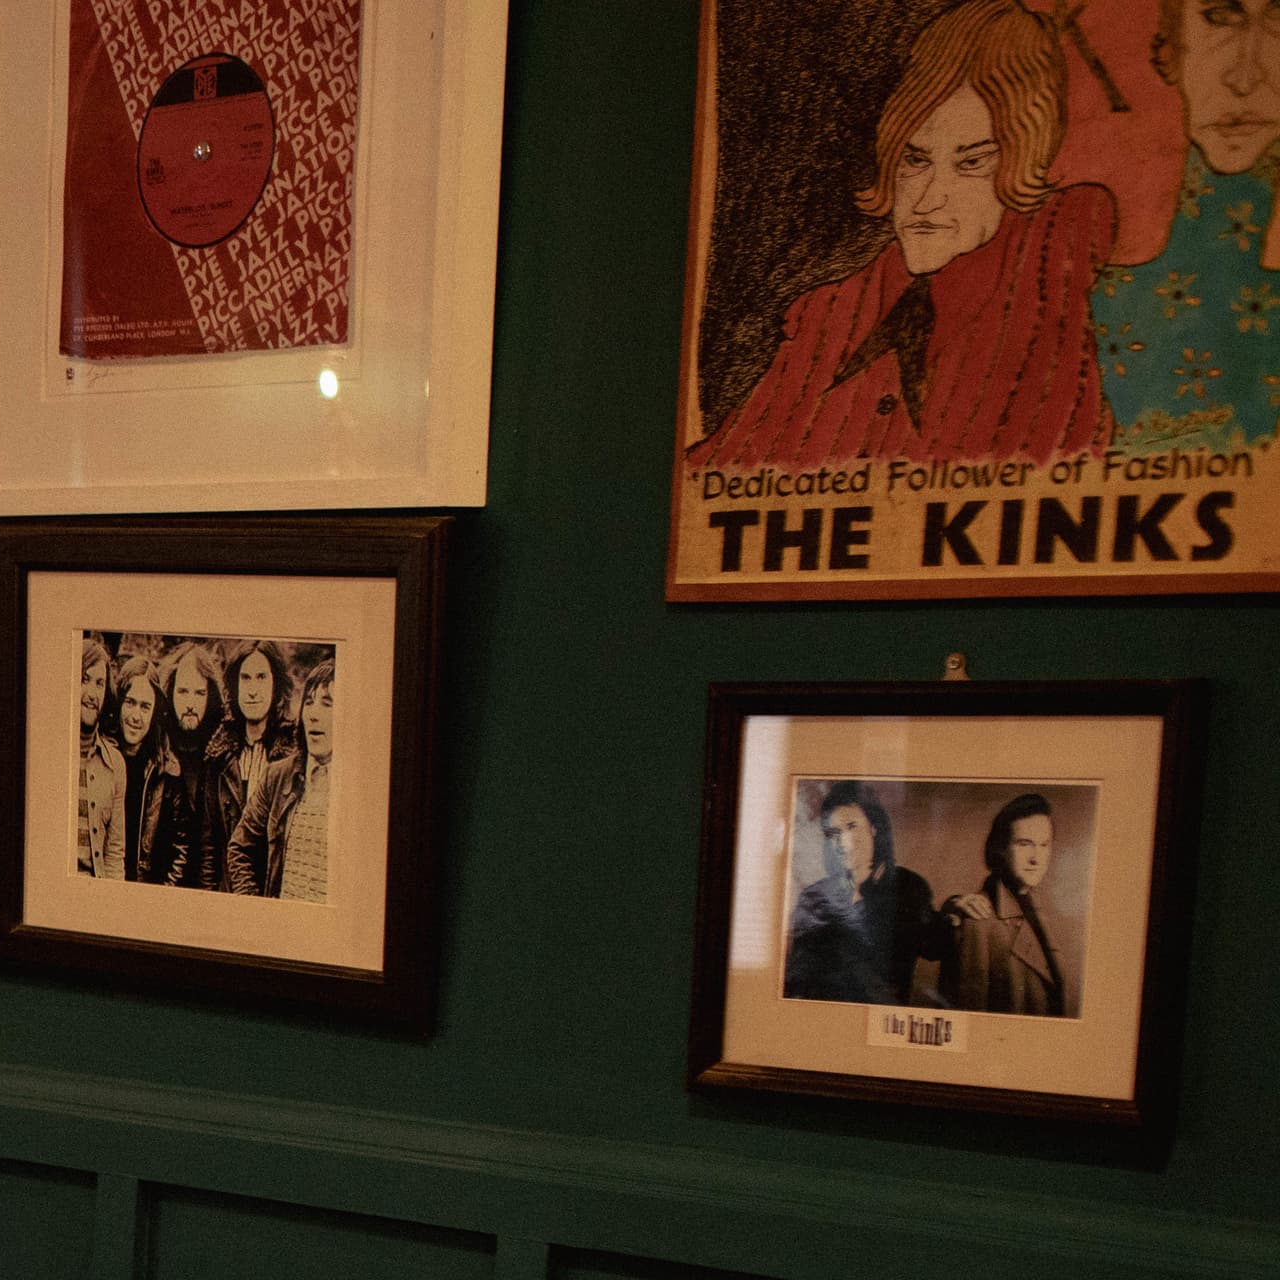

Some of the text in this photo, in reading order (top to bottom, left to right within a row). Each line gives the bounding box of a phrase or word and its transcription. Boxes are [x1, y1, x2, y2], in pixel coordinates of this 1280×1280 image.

[106, 18, 143, 63] PYE
[113, 38, 149, 83] PYE
[263, 29, 304, 77] PYE
[291, 112, 333, 158] PYE
[183, 166, 329, 298] PYE PYE JAZZ
[190, 275, 229, 318] PYE
[237, 226, 289, 282] JAZZ
[197, 233, 310, 338] PICCADILLY
[257, 300, 296, 342] PYE
[888, 460, 1034, 491] Follower
[1050, 452, 1088, 484] of
[709, 491, 1236, 572] THE KINKS
